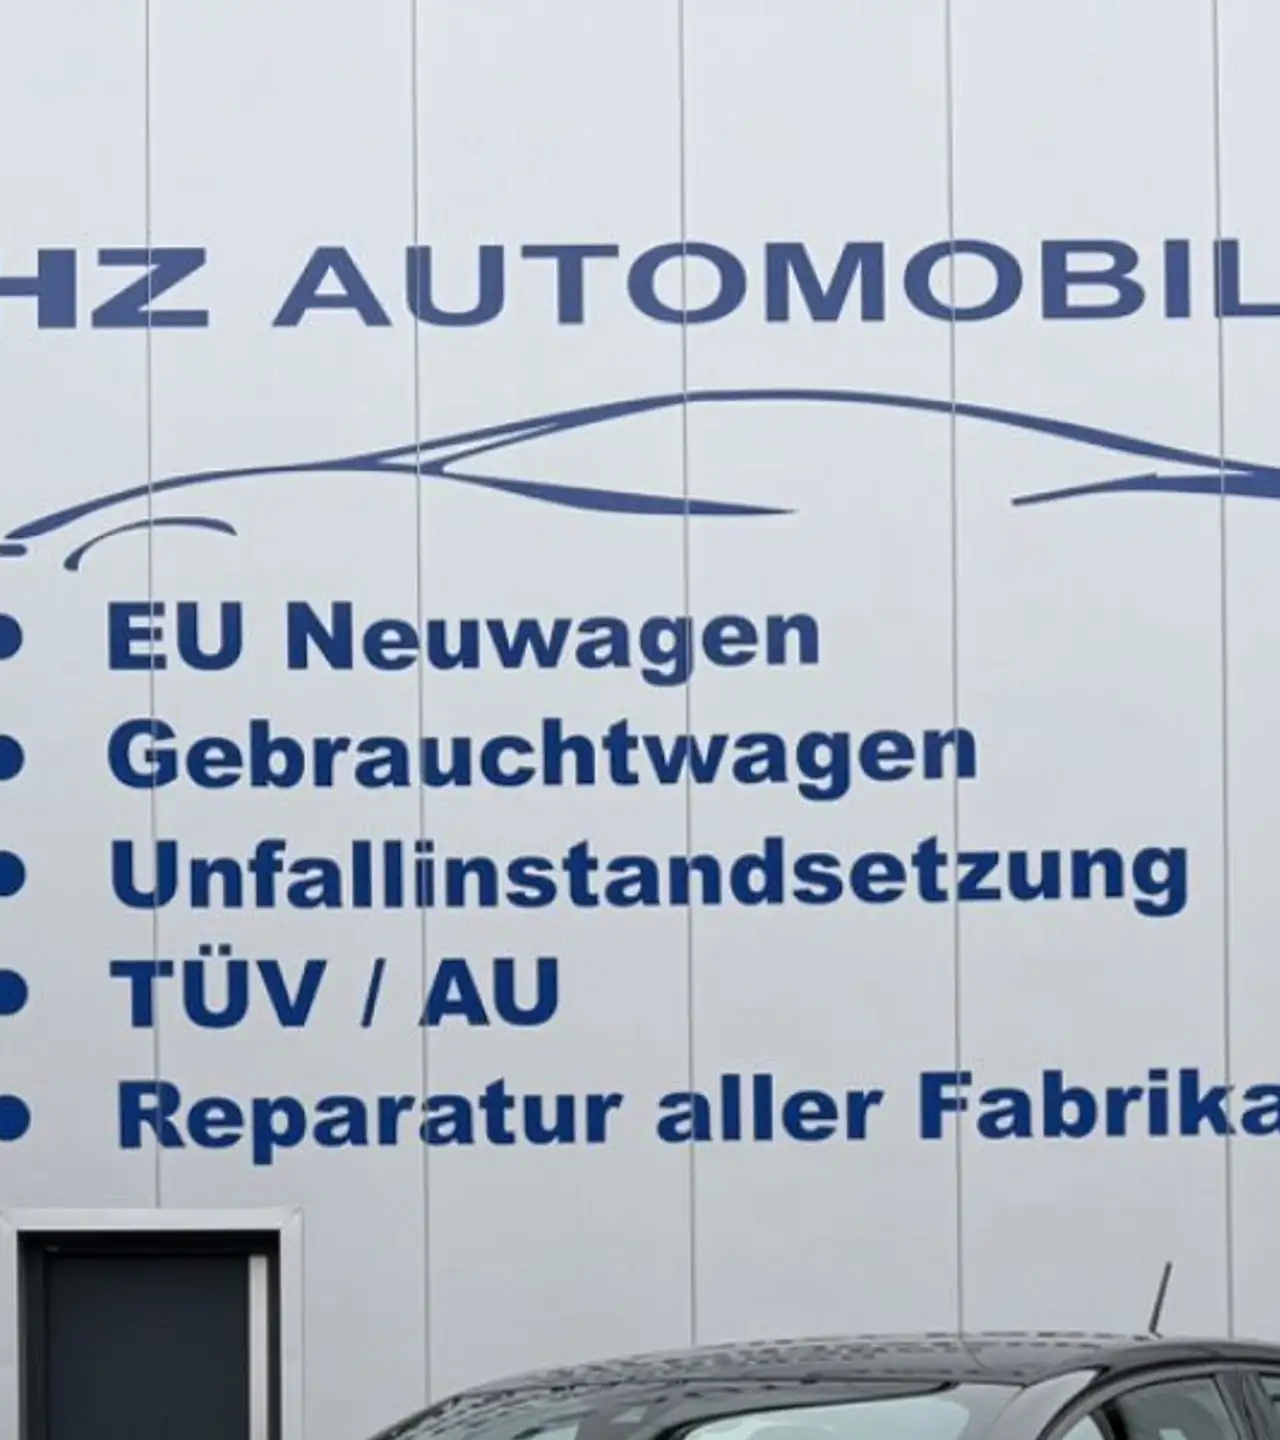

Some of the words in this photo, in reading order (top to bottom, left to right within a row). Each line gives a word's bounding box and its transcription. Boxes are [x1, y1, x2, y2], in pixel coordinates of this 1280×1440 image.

[107, 601, 245, 672] EU
[286, 601, 822, 686] Neuwagen
[107, 717, 979, 803] Gebrauchtwagen
[111, 836, 1190, 919] Unfallinstandsetzung
[109, 944, 327, 1030] TÜV
[360, 958, 386, 1028] /
[419, 957, 560, 1029] AU
[116, 1080, 621, 1167] Reparatur
[657, 1072, 884, 1145] aller
